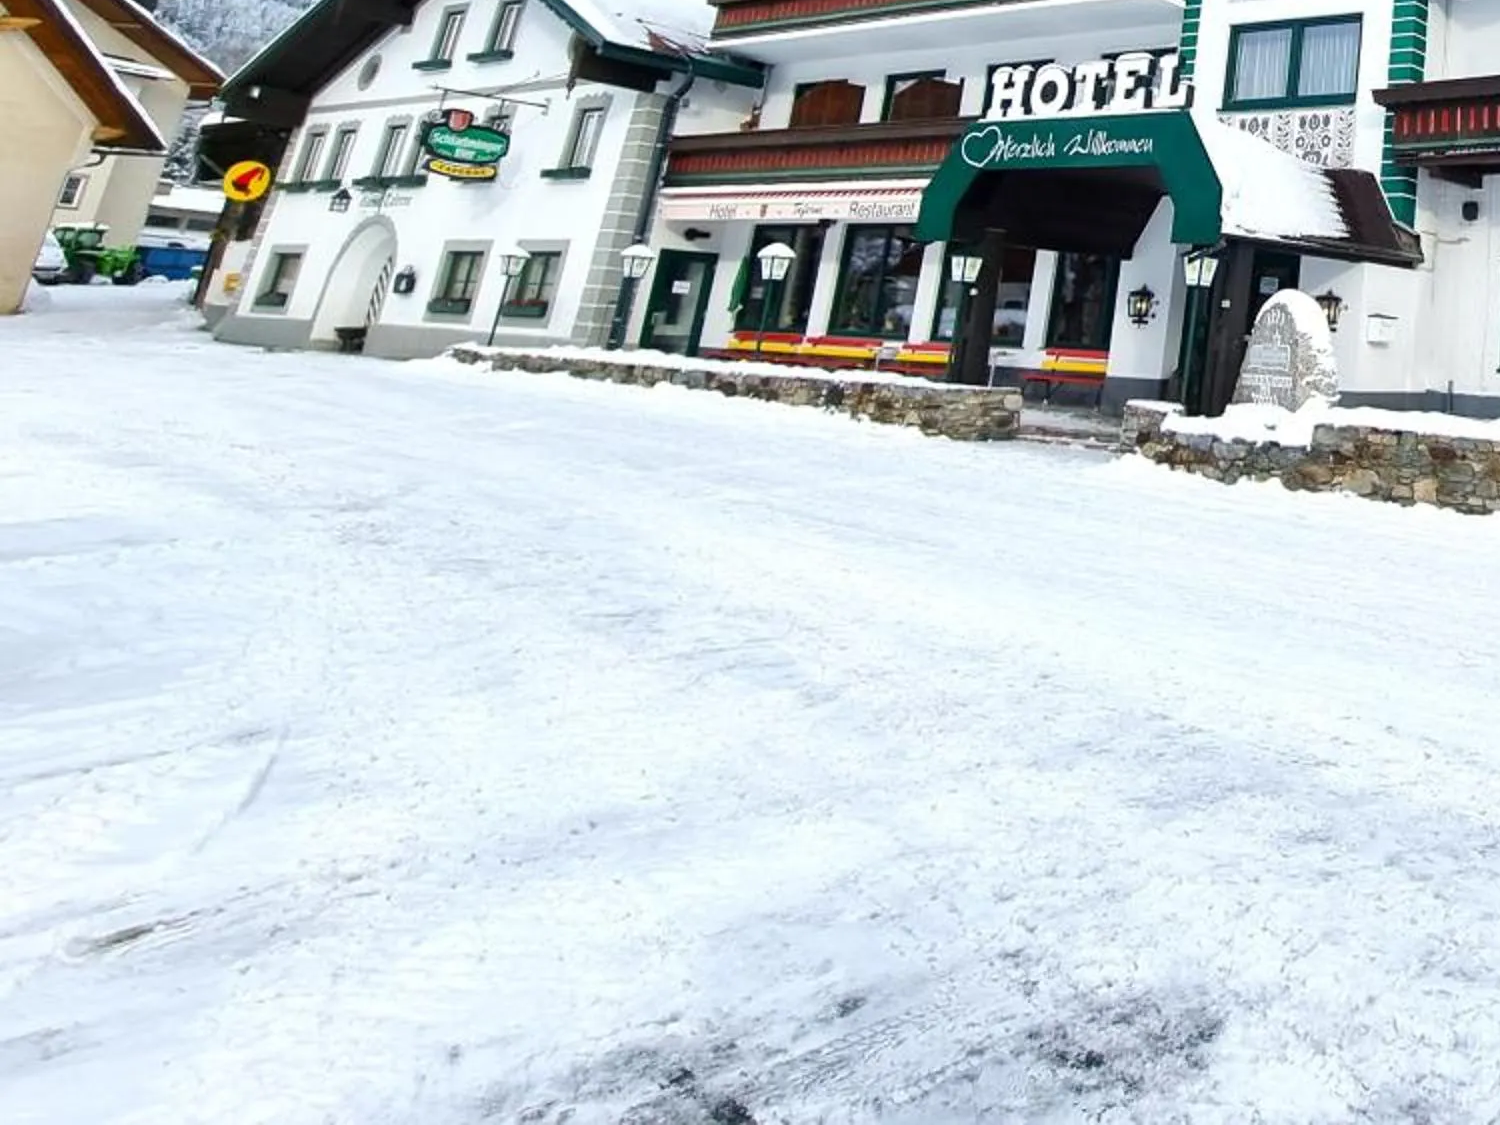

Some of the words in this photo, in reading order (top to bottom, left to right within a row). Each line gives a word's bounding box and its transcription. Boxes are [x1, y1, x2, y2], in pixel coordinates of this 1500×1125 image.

[986, 53, 1194, 119] HOTEL
[994, 132, 1055, 162] Herzlich
[849, 201, 915, 218] Restaurant
